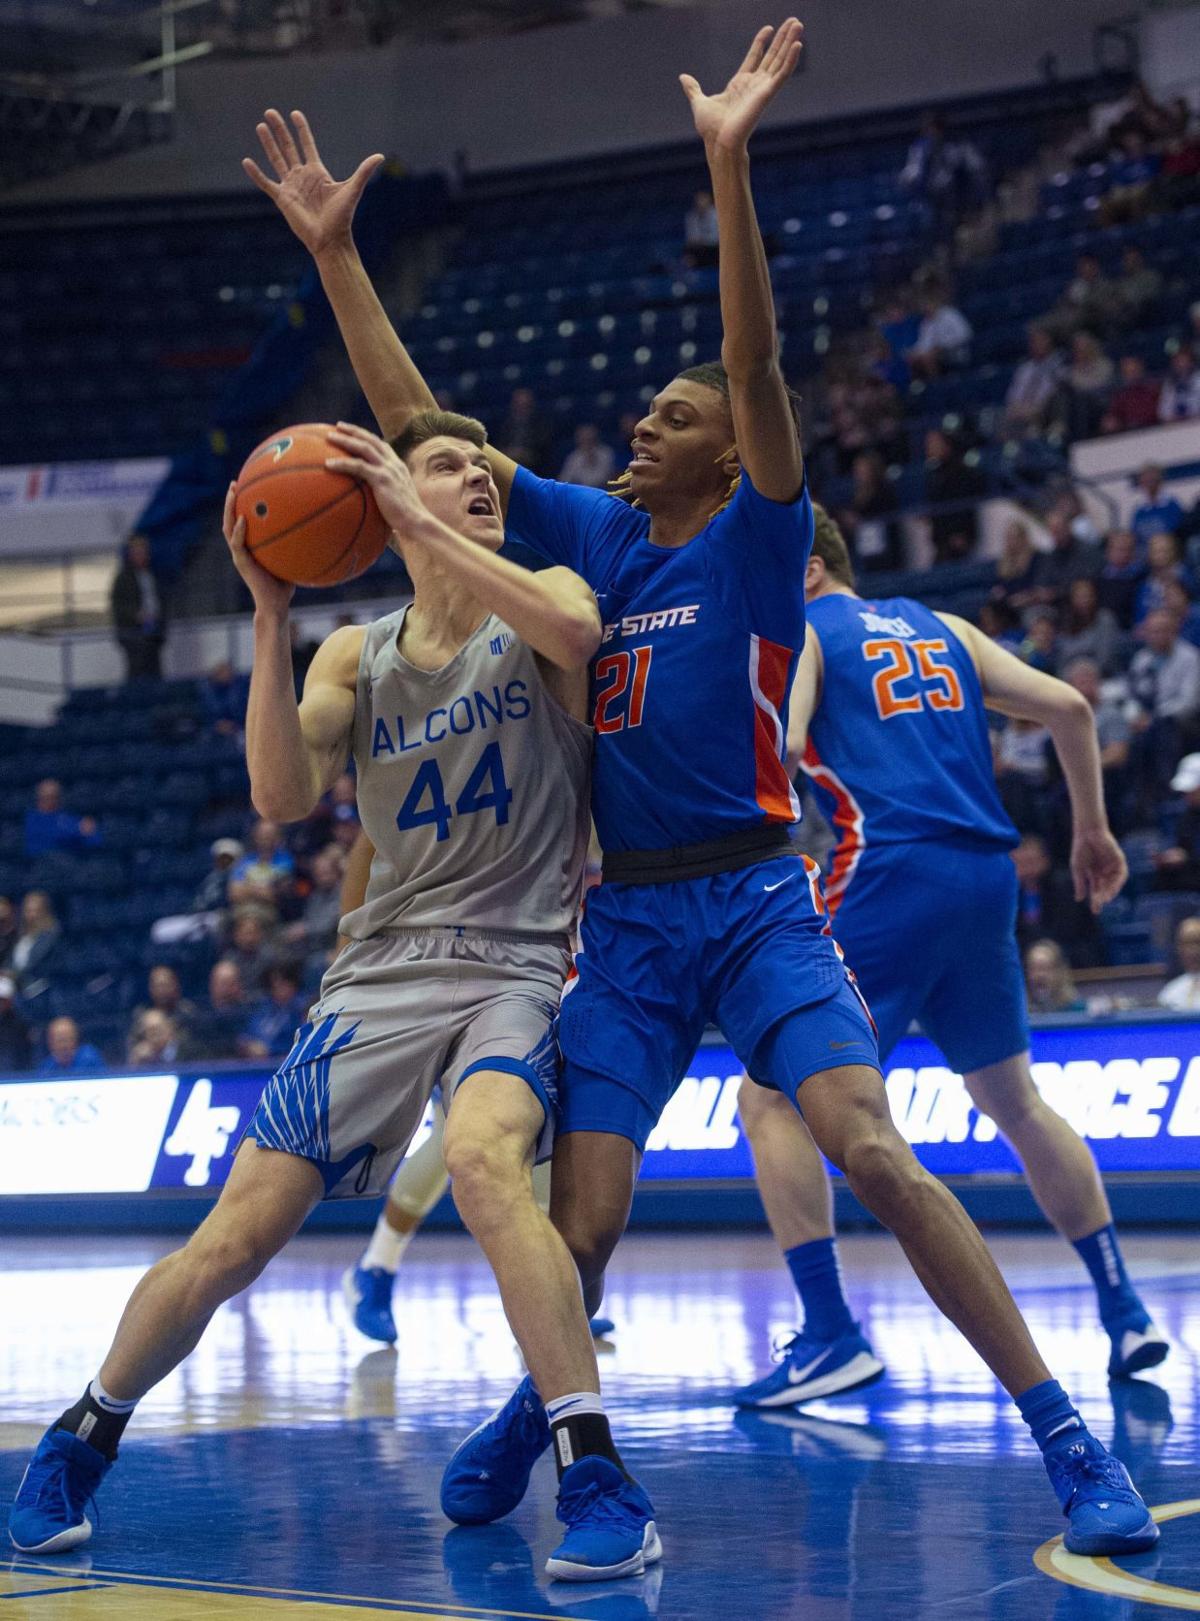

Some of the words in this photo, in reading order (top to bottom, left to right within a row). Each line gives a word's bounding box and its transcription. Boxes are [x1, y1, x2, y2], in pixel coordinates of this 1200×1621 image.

[621, 604, 700, 637] STATE
[593, 645, 653, 735] 21
[862, 638, 964, 721] 25
[395, 740, 514, 843] 44
